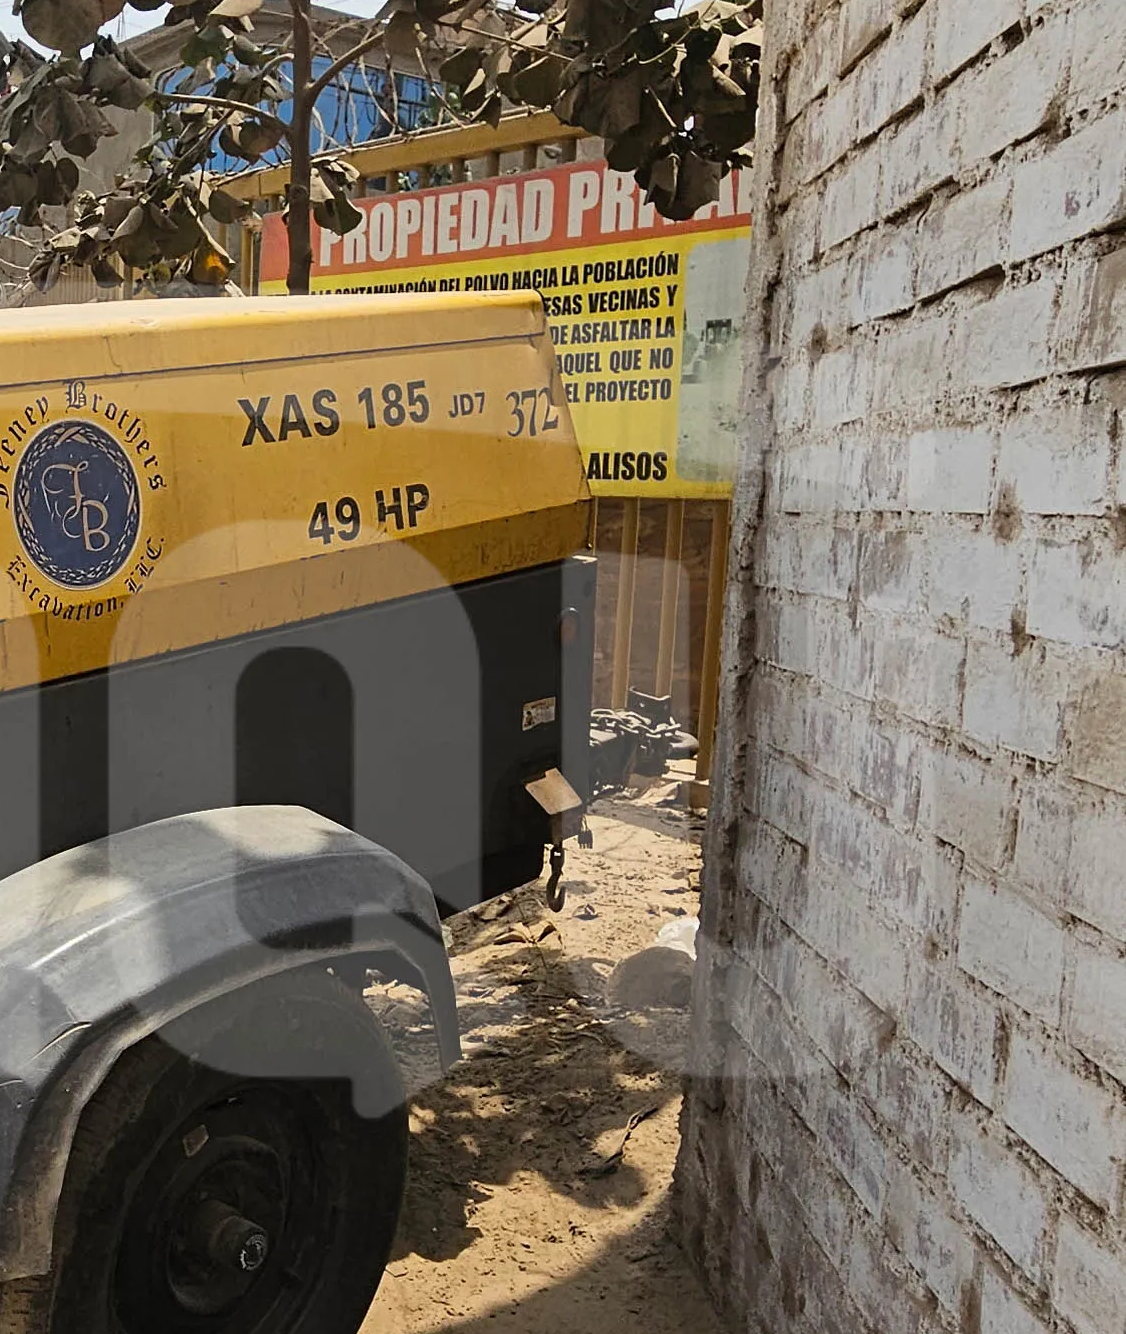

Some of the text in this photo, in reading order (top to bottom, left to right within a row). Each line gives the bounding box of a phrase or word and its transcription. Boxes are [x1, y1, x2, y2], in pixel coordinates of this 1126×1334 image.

[512, 266, 558, 289] HACIA
[561, 265, 579, 287] LA
[583, 251, 679, 285] POBLACIÓN
[588, 288, 660, 314] VECINAS
[665, 285, 678, 307] Y
[570, 319, 652, 345] ASFALTAR
[656, 316, 675, 338] LA
[610, 349, 642, 374] QUE
[649, 347, 674, 370] NO
[585, 378, 672, 403] PROYECTO
[237, 380, 486, 447] XAS 185 JD7
[506, 386, 560, 438] 372
[62, 379, 168, 492] Brothers
[587, 452, 668, 481] ALISOS
[307, 483, 430, 545] 49 HP
